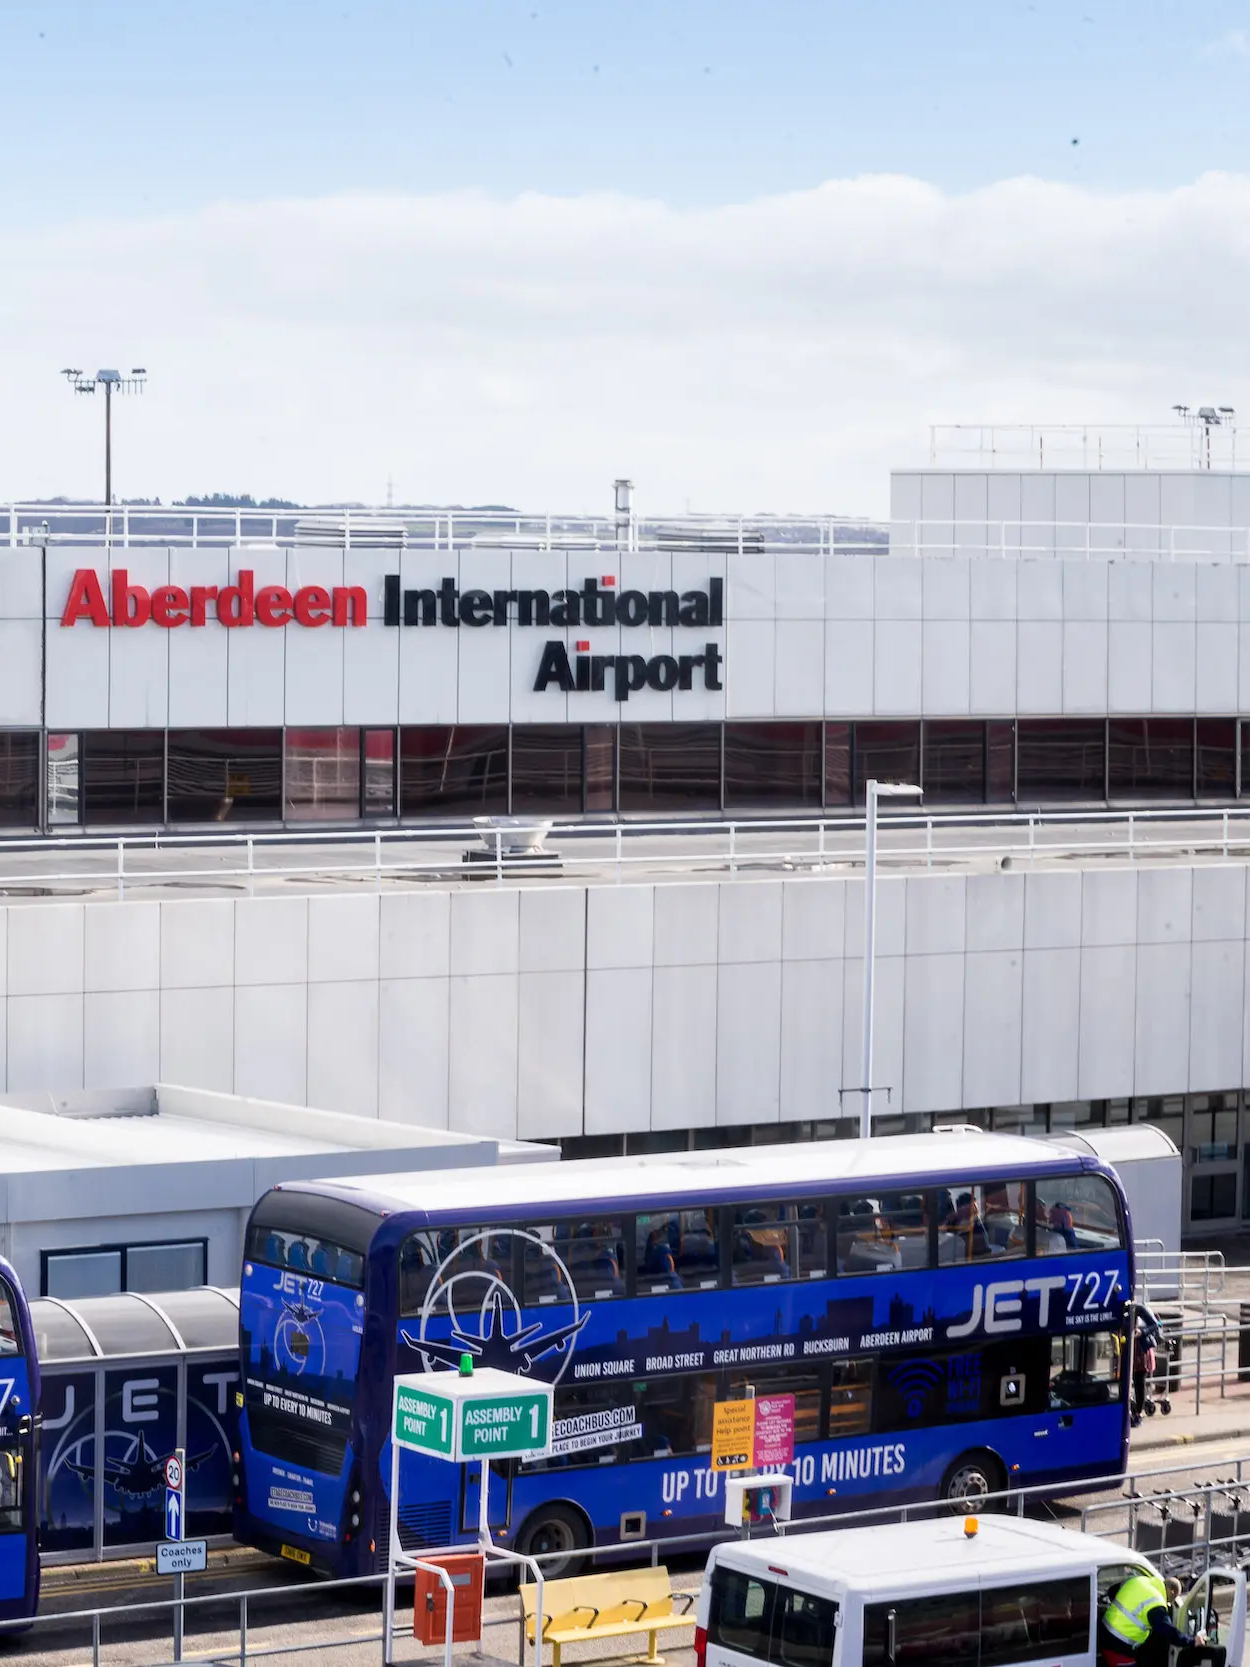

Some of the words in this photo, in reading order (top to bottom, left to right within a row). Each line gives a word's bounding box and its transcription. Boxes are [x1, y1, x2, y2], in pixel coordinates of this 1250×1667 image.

[60, 568, 368, 628] Aberdeen
[383, 574, 723, 628] International
[532, 639, 723, 702] Airport
[272, 1271, 308, 1296] JET
[307, 1278, 324, 1296] 727
[946, 1275, 1067, 1339] JET
[1067, 1269, 1120, 1313] 727
[803, 1337, 850, 1355] BUCKSBURN
[859, 1331, 900, 1349] ABERDEEN
[900, 1327, 933, 1344] AIRPORT
[646, 1356, 673, 1371] BROAD
[674, 1352, 705, 1369] STREET
[713, 1349, 739, 1364] GREAT
[740, 1344, 782, 1362] NORTHERN
[783, 1342, 795, 1357] RD
[948, 1353, 982, 1375] FREE
[574, 1363, 600, 1379] UNION
[602, 1359, 635, 1376] SQUARE
[263, 1392, 272, 1407] UP
[272, 1395, 280, 1410] TO
[280, 1398, 299, 1415] EVERY
[298, 1402, 306, 1418] 10
[306, 1405, 332, 1426] MINUTES
[398, 1395, 437, 1420] ASSEMBLY
[440, 1407, 448, 1443] 1
[403, 1416, 427, 1436] POINT
[465, 1406, 523, 1426] ASSEMBLY
[529, 1403, 539, 1439] 1
[552, 1406, 634, 1437] ECOACHBUS.COM
[474, 1426, 509, 1443] POINT
[552, 1441, 569, 1453] PLACE
[571, 1440, 579, 1450] TO
[579, 1436, 597, 1447] BEGIN
[598, 1432, 613, 1443] YOUR
[614, 1426, 641, 1440] JOURNEY
[168, 1464, 180, 1481] 20
[791, 1456, 815, 1487] 10
[821, 1443, 906, 1484] MINUTES
[662, 1471, 690, 1503] UP
[694, 1469, 718, 1498] TO
[160, 1545, 202, 1558] Coaches
[171, 1557, 192, 1569] only
